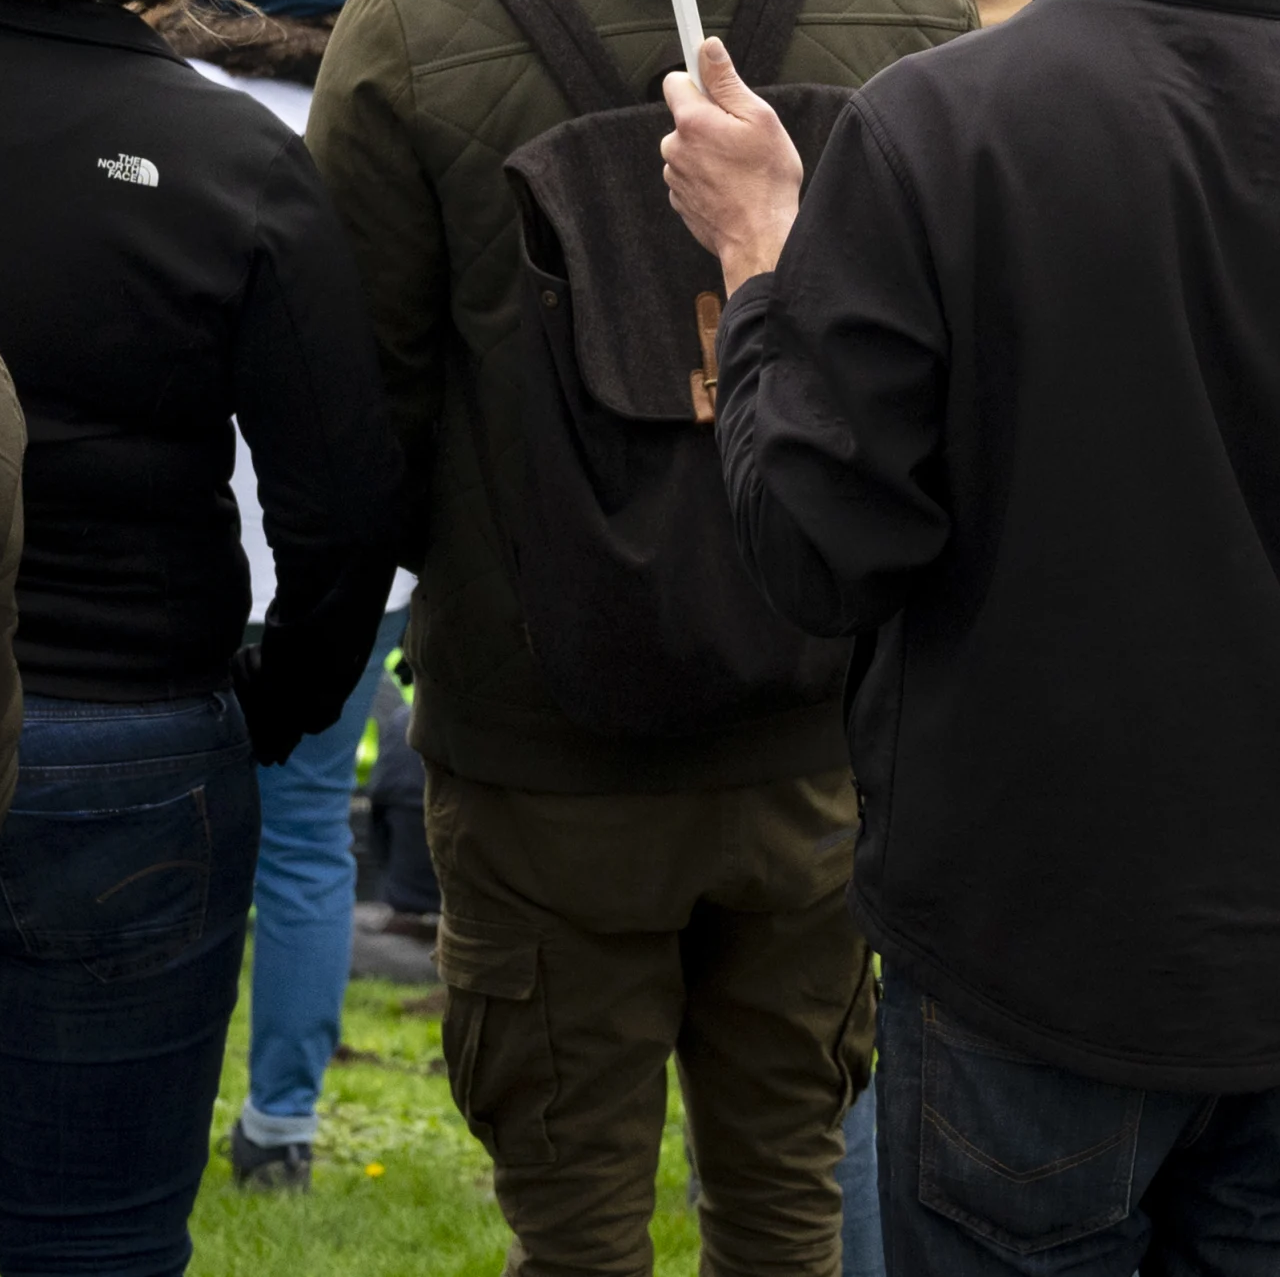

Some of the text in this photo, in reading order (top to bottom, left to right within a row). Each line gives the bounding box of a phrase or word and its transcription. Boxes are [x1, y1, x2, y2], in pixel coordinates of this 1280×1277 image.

[97, 158, 139, 175] NORTH
[118, 153, 141, 166] THE
[108, 168, 138, 183] FACE
